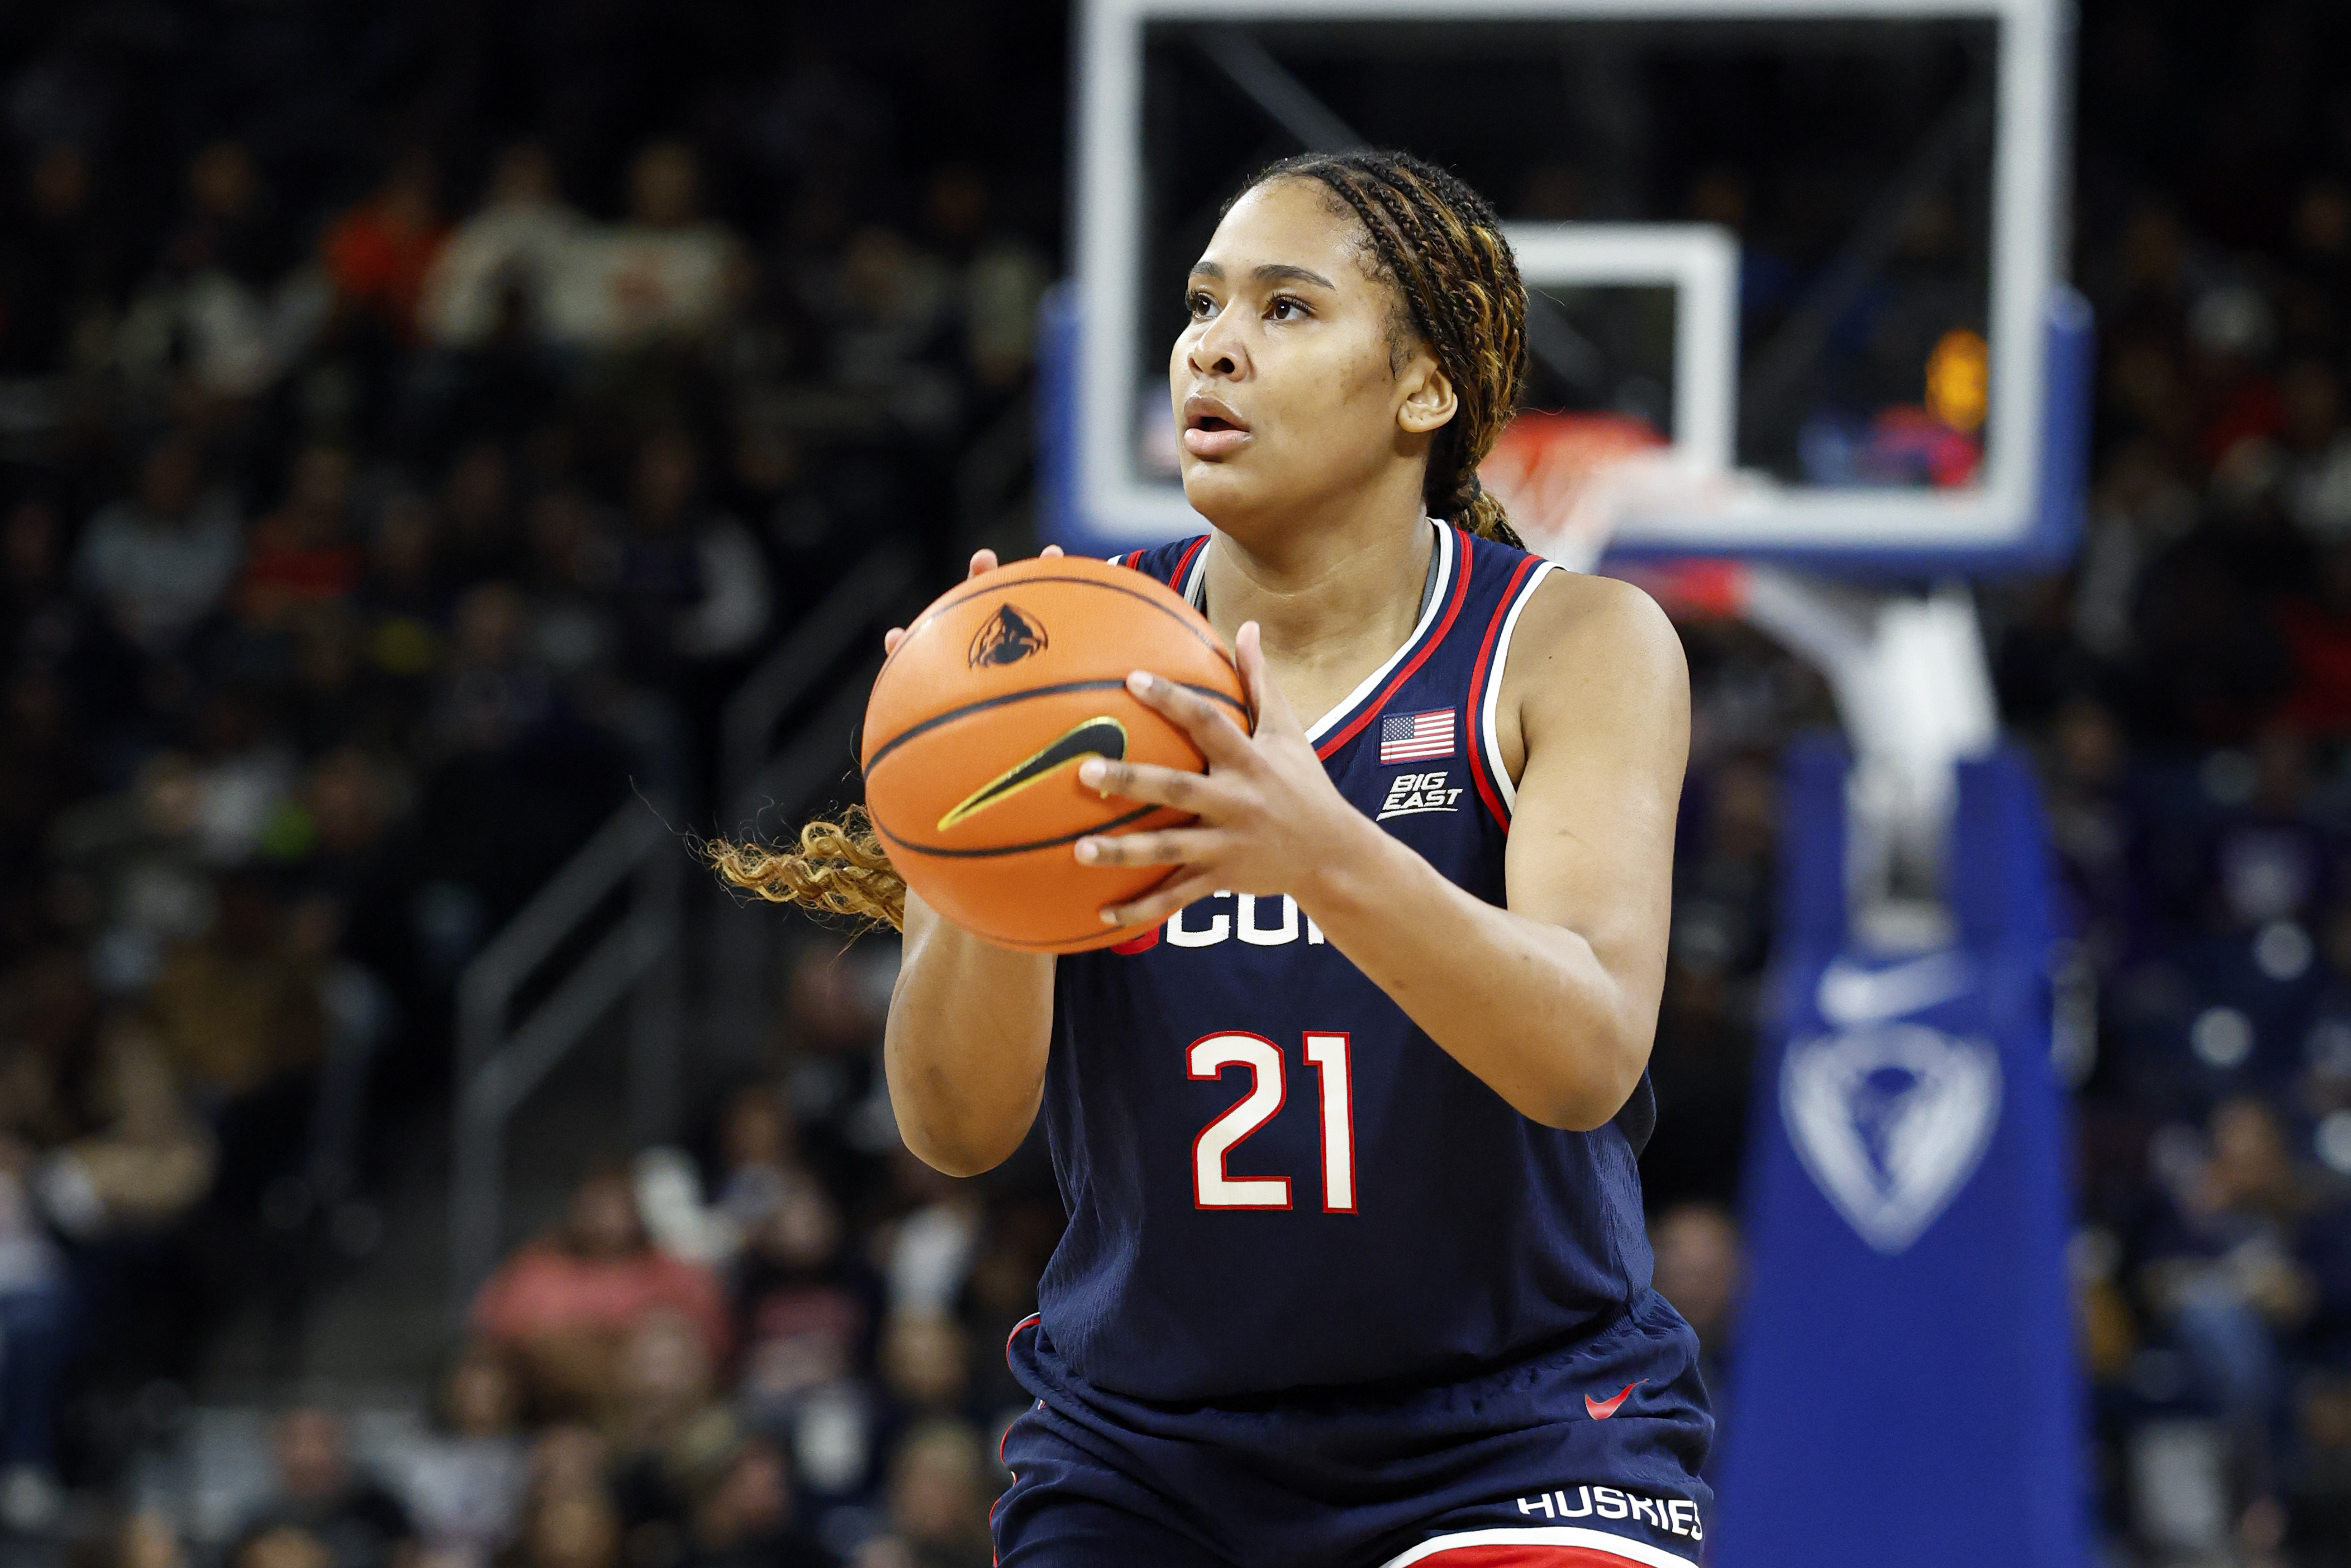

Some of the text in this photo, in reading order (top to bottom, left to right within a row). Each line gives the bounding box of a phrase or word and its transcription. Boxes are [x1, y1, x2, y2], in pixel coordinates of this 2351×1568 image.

[1382, 788, 1463, 811] EAST
[1389, 771, 1448, 793] BIG
[1185, 1030, 1359, 1214] 21
[1516, 1485, 1703, 1541] HUSKIES
